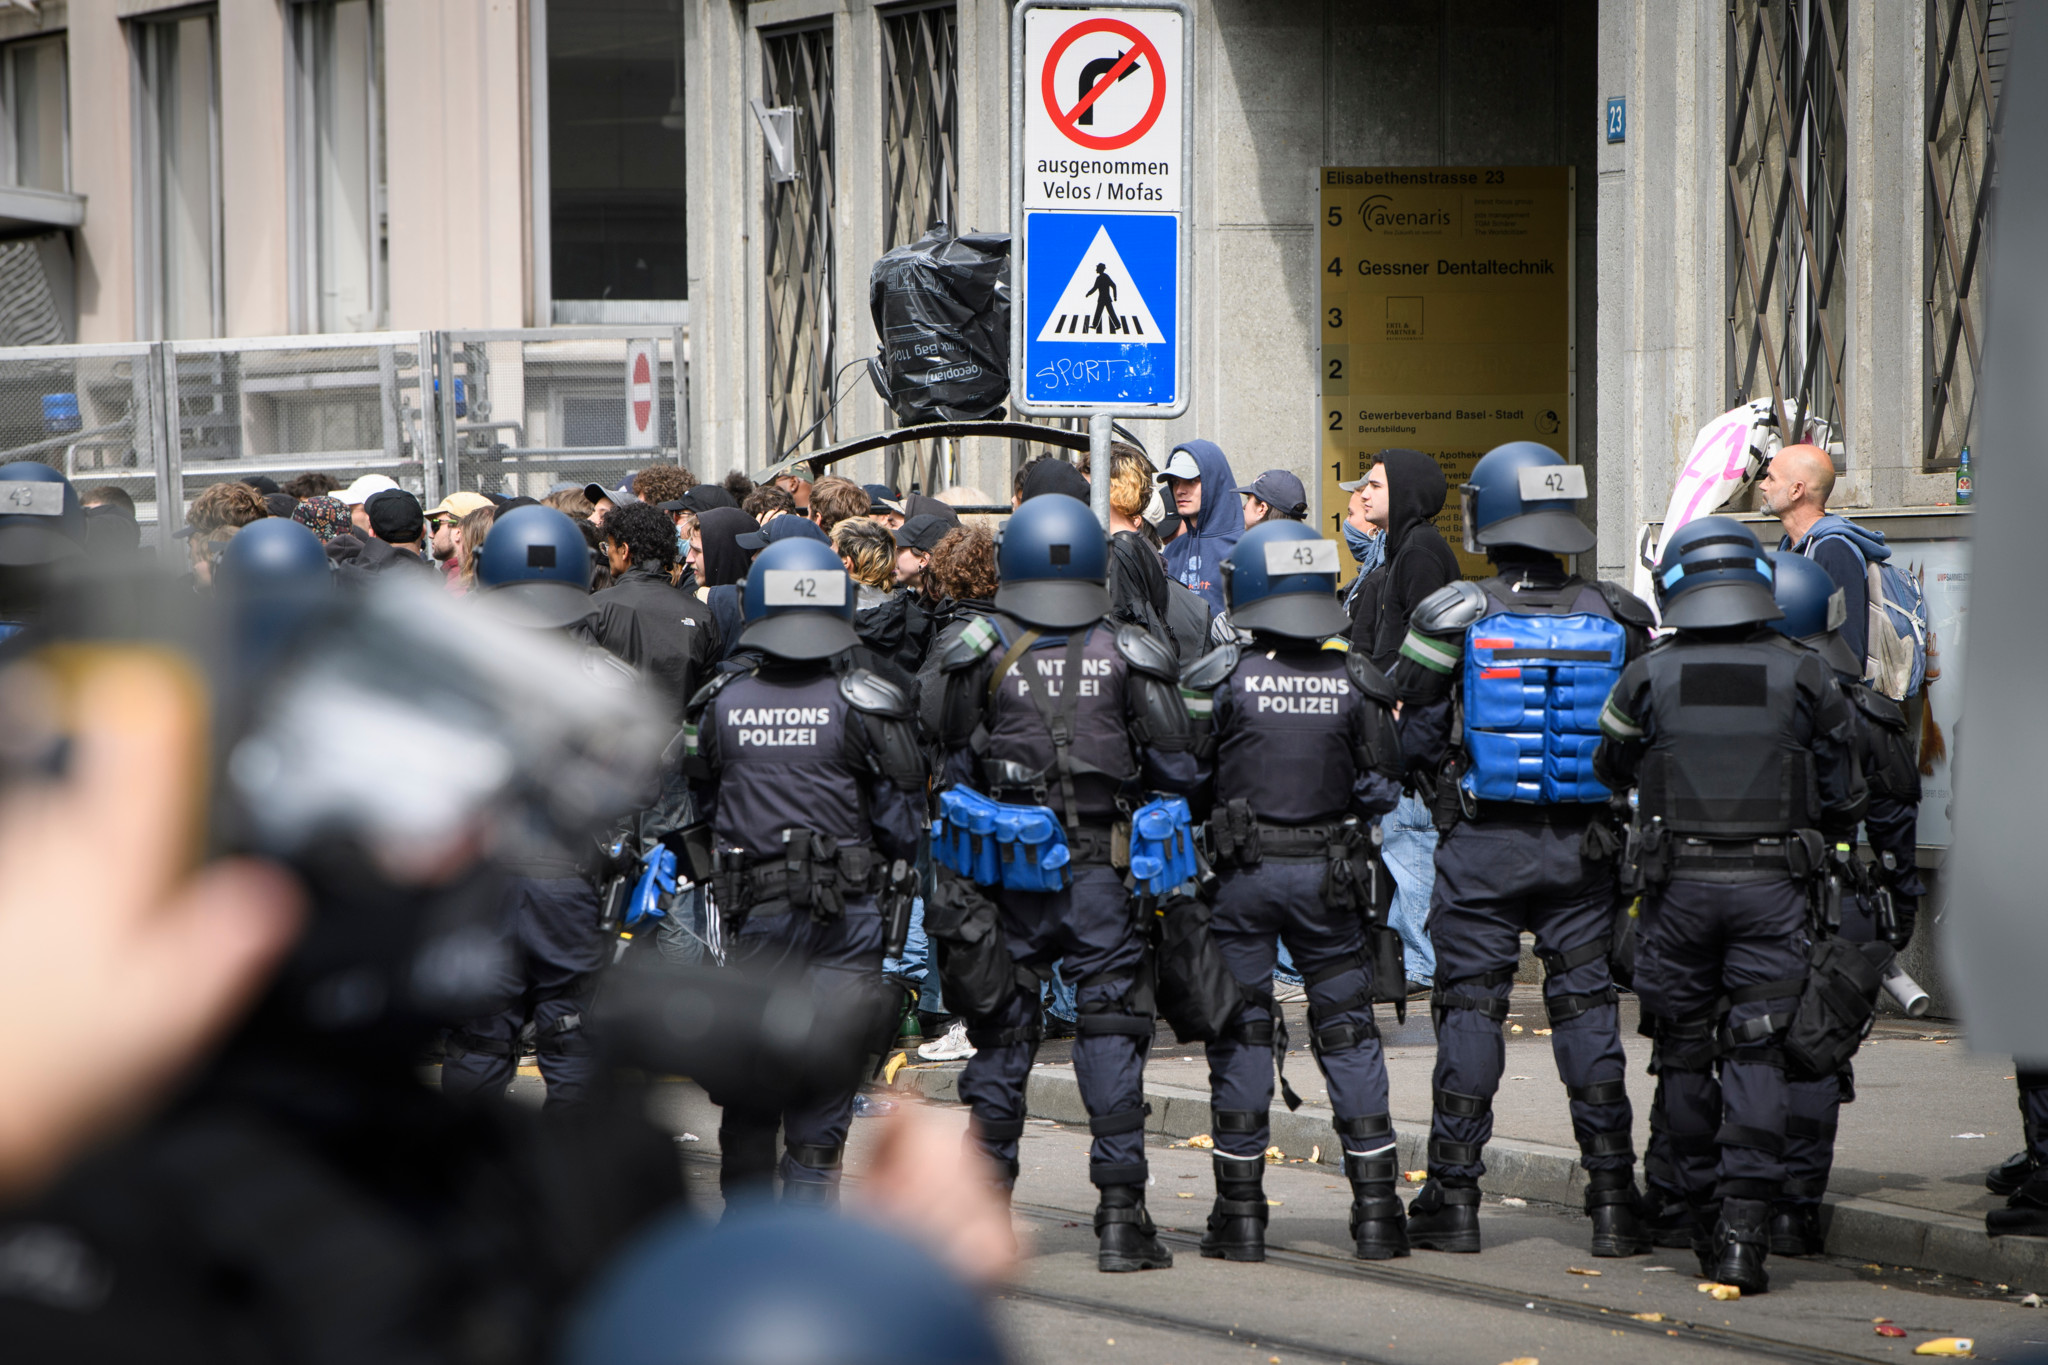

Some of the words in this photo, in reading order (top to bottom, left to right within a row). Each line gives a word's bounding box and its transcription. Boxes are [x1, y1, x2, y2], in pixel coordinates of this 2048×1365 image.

[1610, 105, 1622, 133] 23
[1037, 159, 1169, 179] ausgenommen
[1326, 170, 1478, 185] Elisabethenstrasse
[1485, 170, 1505, 185] 23
[1043, 180, 1091, 199] Velos
[1096, 182, 1103, 200] /
[1108, 182, 1163, 201] Mofas
[1327, 206, 1343, 227] 5
[1375, 209, 1450, 226] avenaris
[1327, 257, 1343, 277] 4
[1358, 260, 1430, 276] Gessner
[1437, 259, 1555, 275] Dentaltechnik
[1328, 307, 1343, 328] 3
[914, 343, 939, 356] Bag
[930, 364, 979, 382] oecoplan
[1035, 358, 1130, 389] SPORT
[1328, 359, 1343, 379] 2
[1328, 410, 1343, 431] 2
[1358, 410, 1452, 421] Gewerbeverband
[1456, 410, 1487, 420] Basel
[1495, 409, 1524, 420] Stadt
[1358, 424, 1416, 435] Berufsbildung
[1440, 451, 1486, 461] Apotheke
[1331, 462, 1341, 481] 1
[1440, 462, 1456, 470] rein
[1545, 474, 1565, 492] 42
[9, 487, 33, 507] 43
[1331, 513, 1341, 533] 1
[1293, 546, 1314, 565] 43
[794, 578, 817, 598] 42
[1006, 659, 1113, 677] KNTNS
[1018, 679, 1100, 697] PLEI
[1245, 676, 1350, 695] KANTONS
[1257, 695, 1339, 715] POLIZEI
[728, 708, 830, 726] KANTONS
[738, 728, 817, 747] POLIZEI
